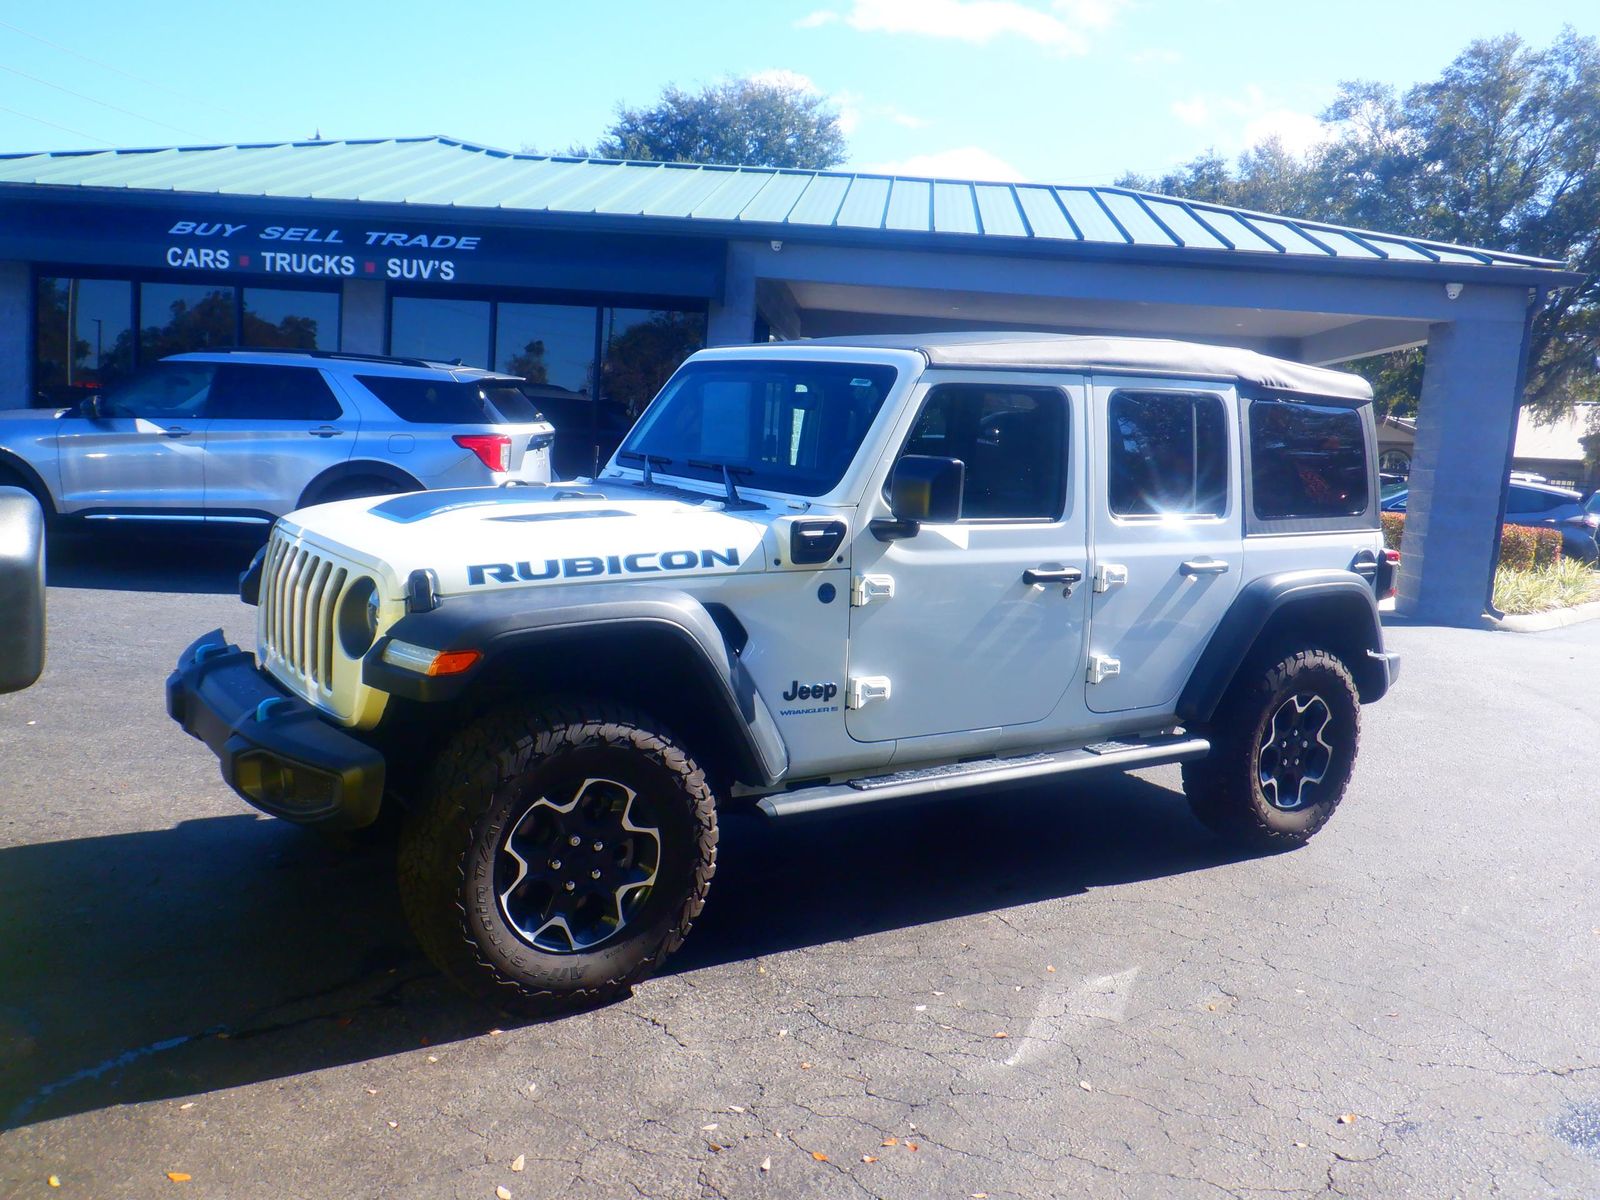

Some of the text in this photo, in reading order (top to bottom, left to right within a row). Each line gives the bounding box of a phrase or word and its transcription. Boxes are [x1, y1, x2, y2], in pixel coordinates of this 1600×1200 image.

[168, 221, 481, 250] BUY SELL TRADE
[166, 247, 455, 281] CARS TRUCKS SUV'S
[467, 548, 740, 585] RUBICON
[783, 680, 837, 702] Jeep
[780, 707, 829, 716] WRANGLER
